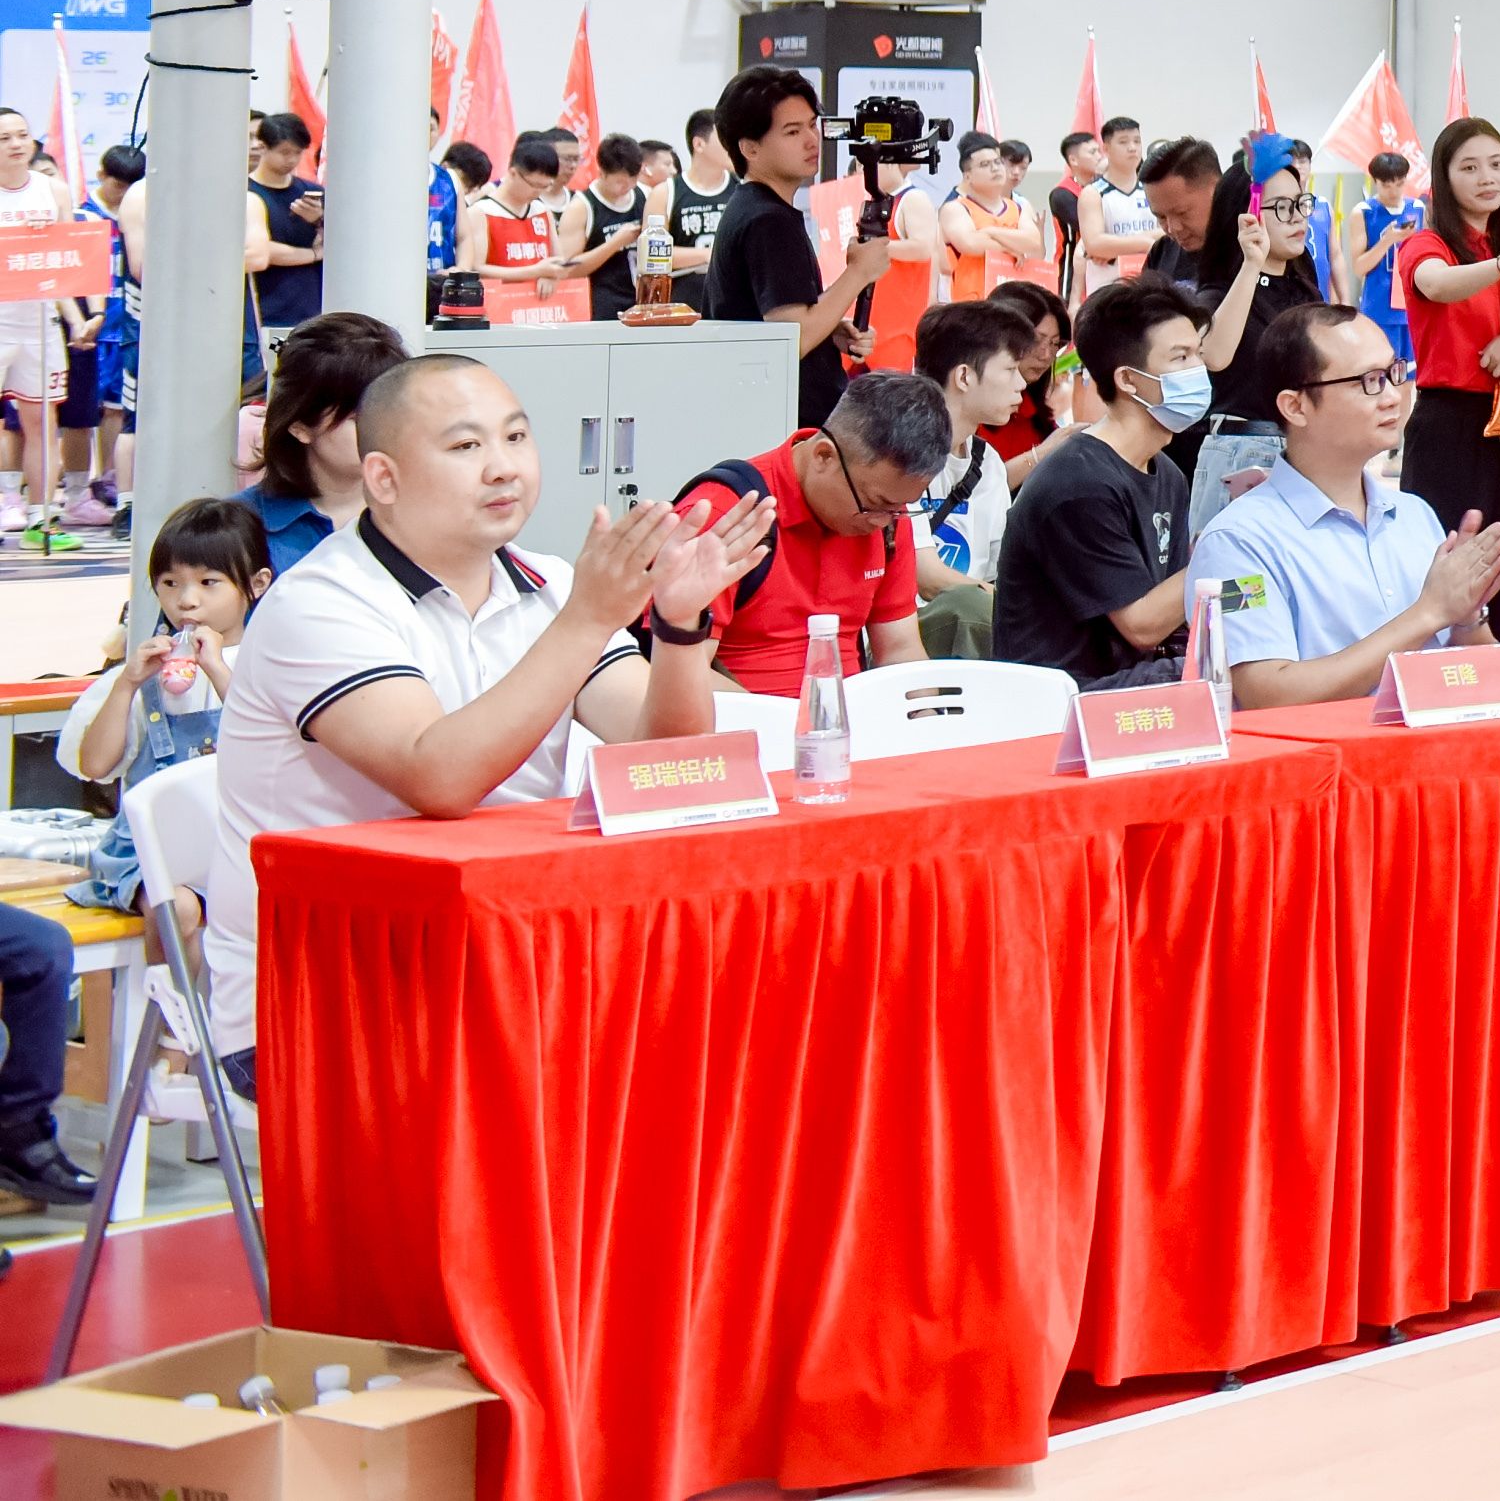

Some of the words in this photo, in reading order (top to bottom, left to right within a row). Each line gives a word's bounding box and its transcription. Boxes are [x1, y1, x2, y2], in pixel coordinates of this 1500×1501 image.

[895, 36, 943, 51] 光都智能
[8, 250, 83, 272] 诗尼曼队
[1439, 663, 1478, 688] 百隆
[1114, 705, 1175, 735] 海蒂诗
[627, 754, 727, 791] 强瑞铝材
